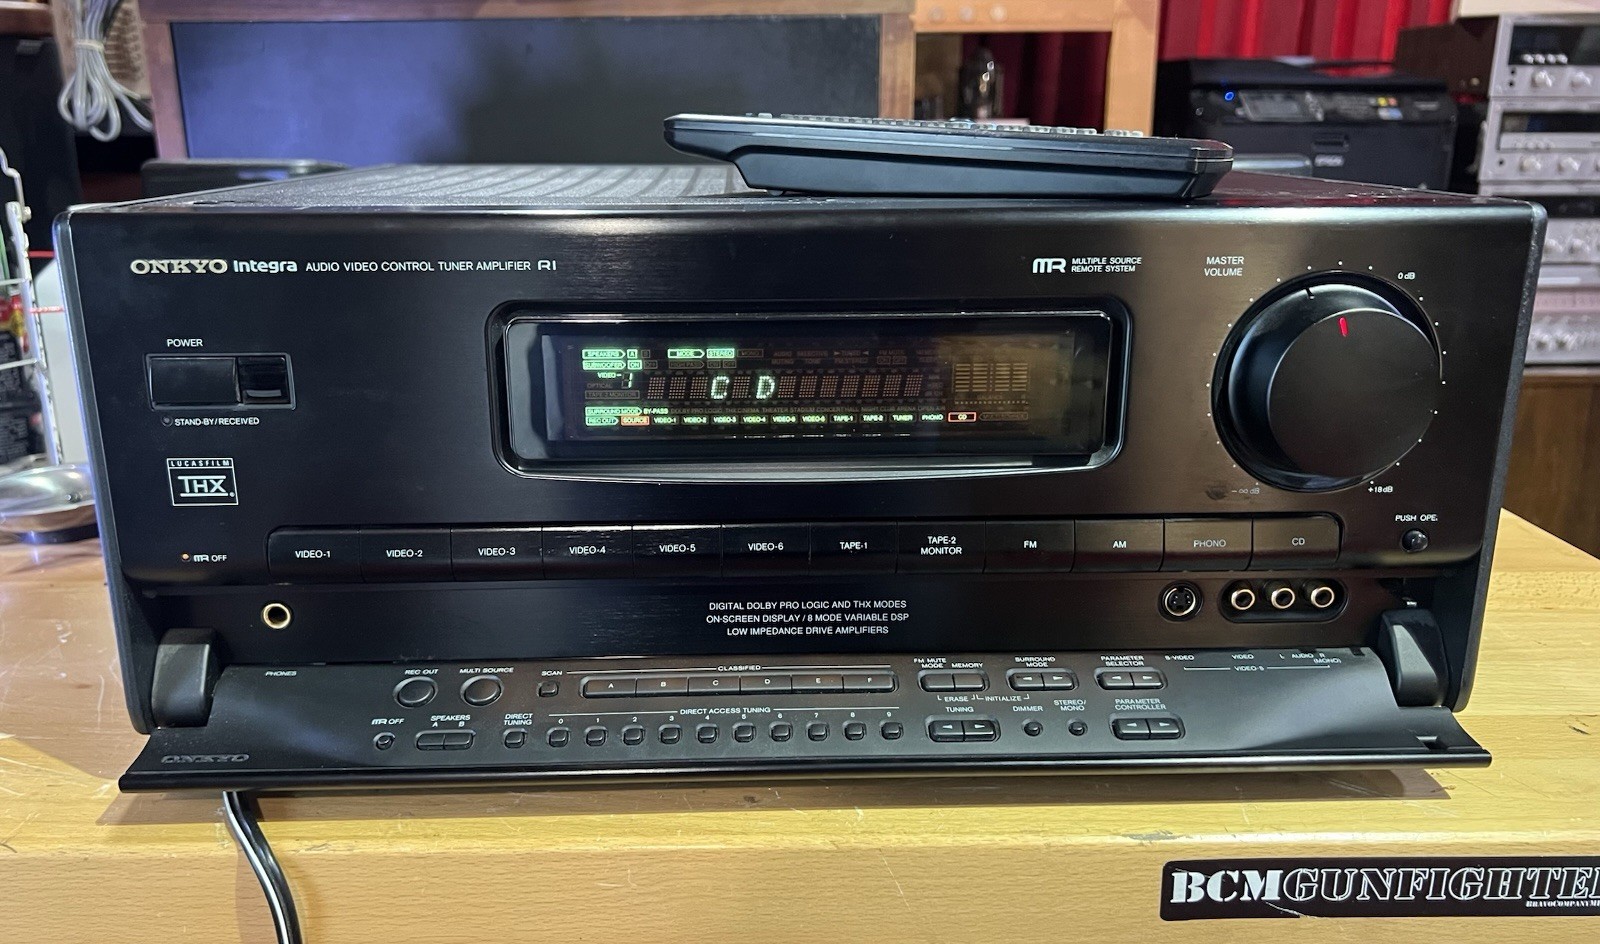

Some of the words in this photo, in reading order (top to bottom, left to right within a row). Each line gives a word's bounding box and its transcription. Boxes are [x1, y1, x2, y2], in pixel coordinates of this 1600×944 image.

[1206, 256, 1244, 265] MASTER
[130, 258, 228, 274] ONKYO
[233, 260, 298, 273] Integra
[306, 262, 340, 271] AUDIO
[343, 262, 378, 271] VIDEO
[381, 262, 434, 271] CONTROL
[438, 262, 474, 271] TUNER
[476, 262, 531, 271] AMPLIFIER
[1204, 268, 1242, 276] VOLUME
[167, 338, 203, 347] POWER
[178, 475, 228, 497] THX
[928, 536, 956, 544] TAPE-2
[1194, 539, 1226, 548] PHONO
[1292, 538, 1305, 546] CD
[569, 546, 606, 554] VIDEO-4
[659, 544, 696, 552] VIDEO-5
[748, 542, 784, 551] VIDEO-6
[920, 546, 962, 555] MONITOR
[295, 550, 330, 558] VIDEO-1
[386, 550, 423, 558] VIDEO-2
[478, 548, 516, 556] VIDEO-3
[212, 554, 227, 562] OFF
[709, 602, 744, 610] DIGITAL
[746, 601, 778, 610] DOLBY
[780, 601, 799, 609] PRO
[802, 601, 830, 609] LOGIC
[832, 600, 851, 608] AND
[853, 600, 872, 608] THX
[874, 600, 906, 608] MODES
[706, 614, 760, 623] ON-SCREEN
[762, 614, 800, 622] DISPLAY
[808, 614, 813, 622] 8
[815, 614, 842, 622] MODE
[844, 614, 888, 622] VARIABLE
[890, 613, 909, 622] DSP
[727, 627, 748, 636] LOW
[750, 627, 803, 636] IMPEDANCE
[806, 626, 833, 635] DRIVE
[835, 626, 888, 634] AMPLIFIERS
[161, 754, 250, 764] ONKYO
